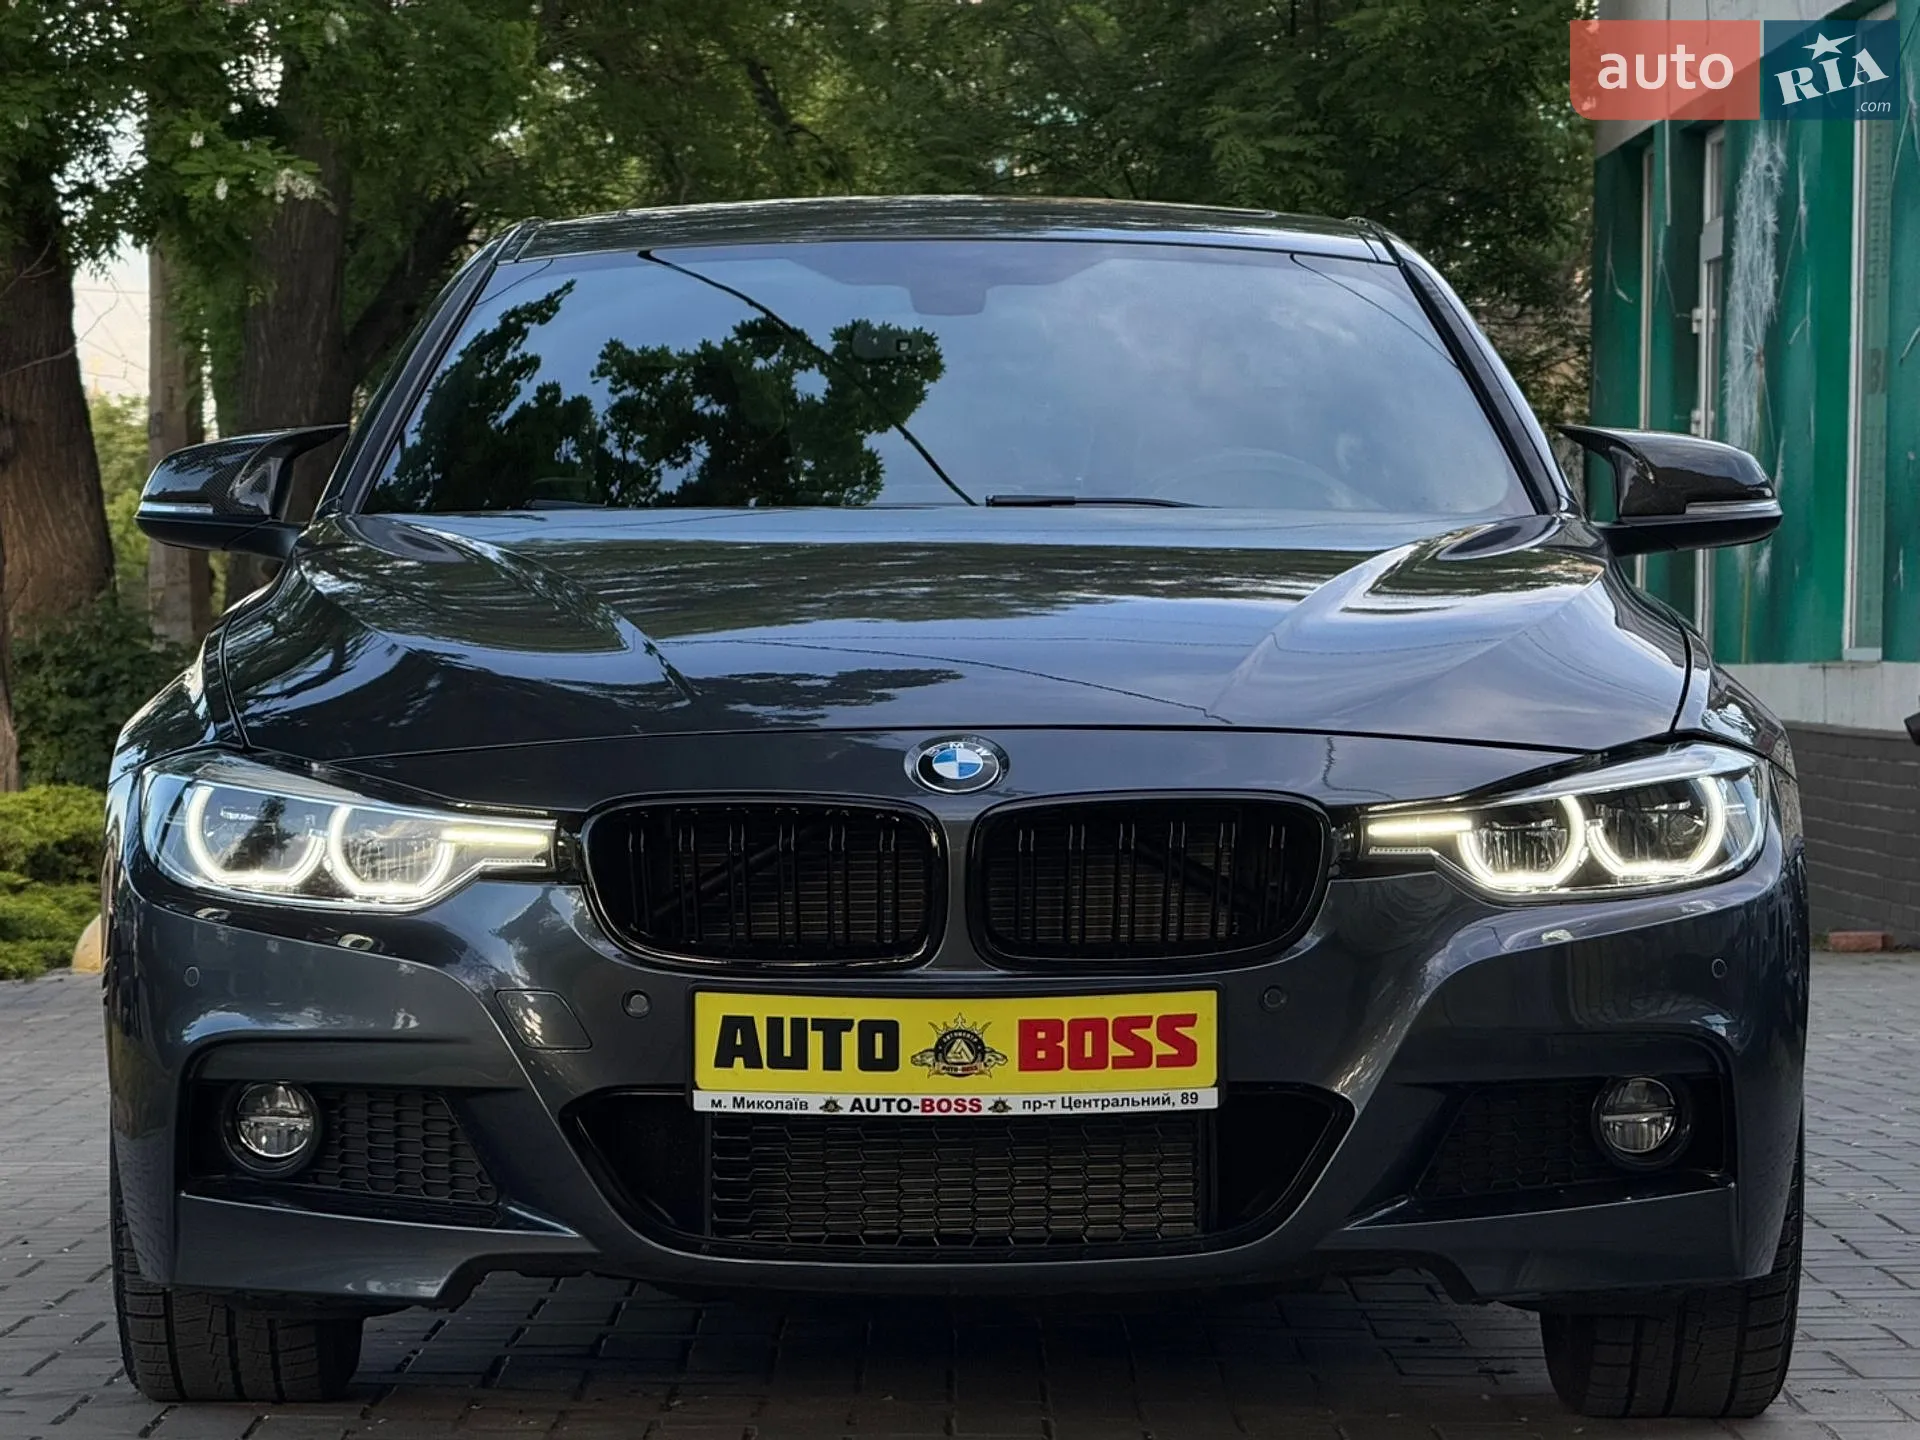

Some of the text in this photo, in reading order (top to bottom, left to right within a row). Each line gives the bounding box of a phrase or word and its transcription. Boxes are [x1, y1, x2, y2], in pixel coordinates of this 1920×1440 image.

[713, 1012, 1199, 1072] AUTO BOSS
[710, 1091, 1199, 1113] м. Миколаїв AUTO-BOSS пр-т Центральний, 89
